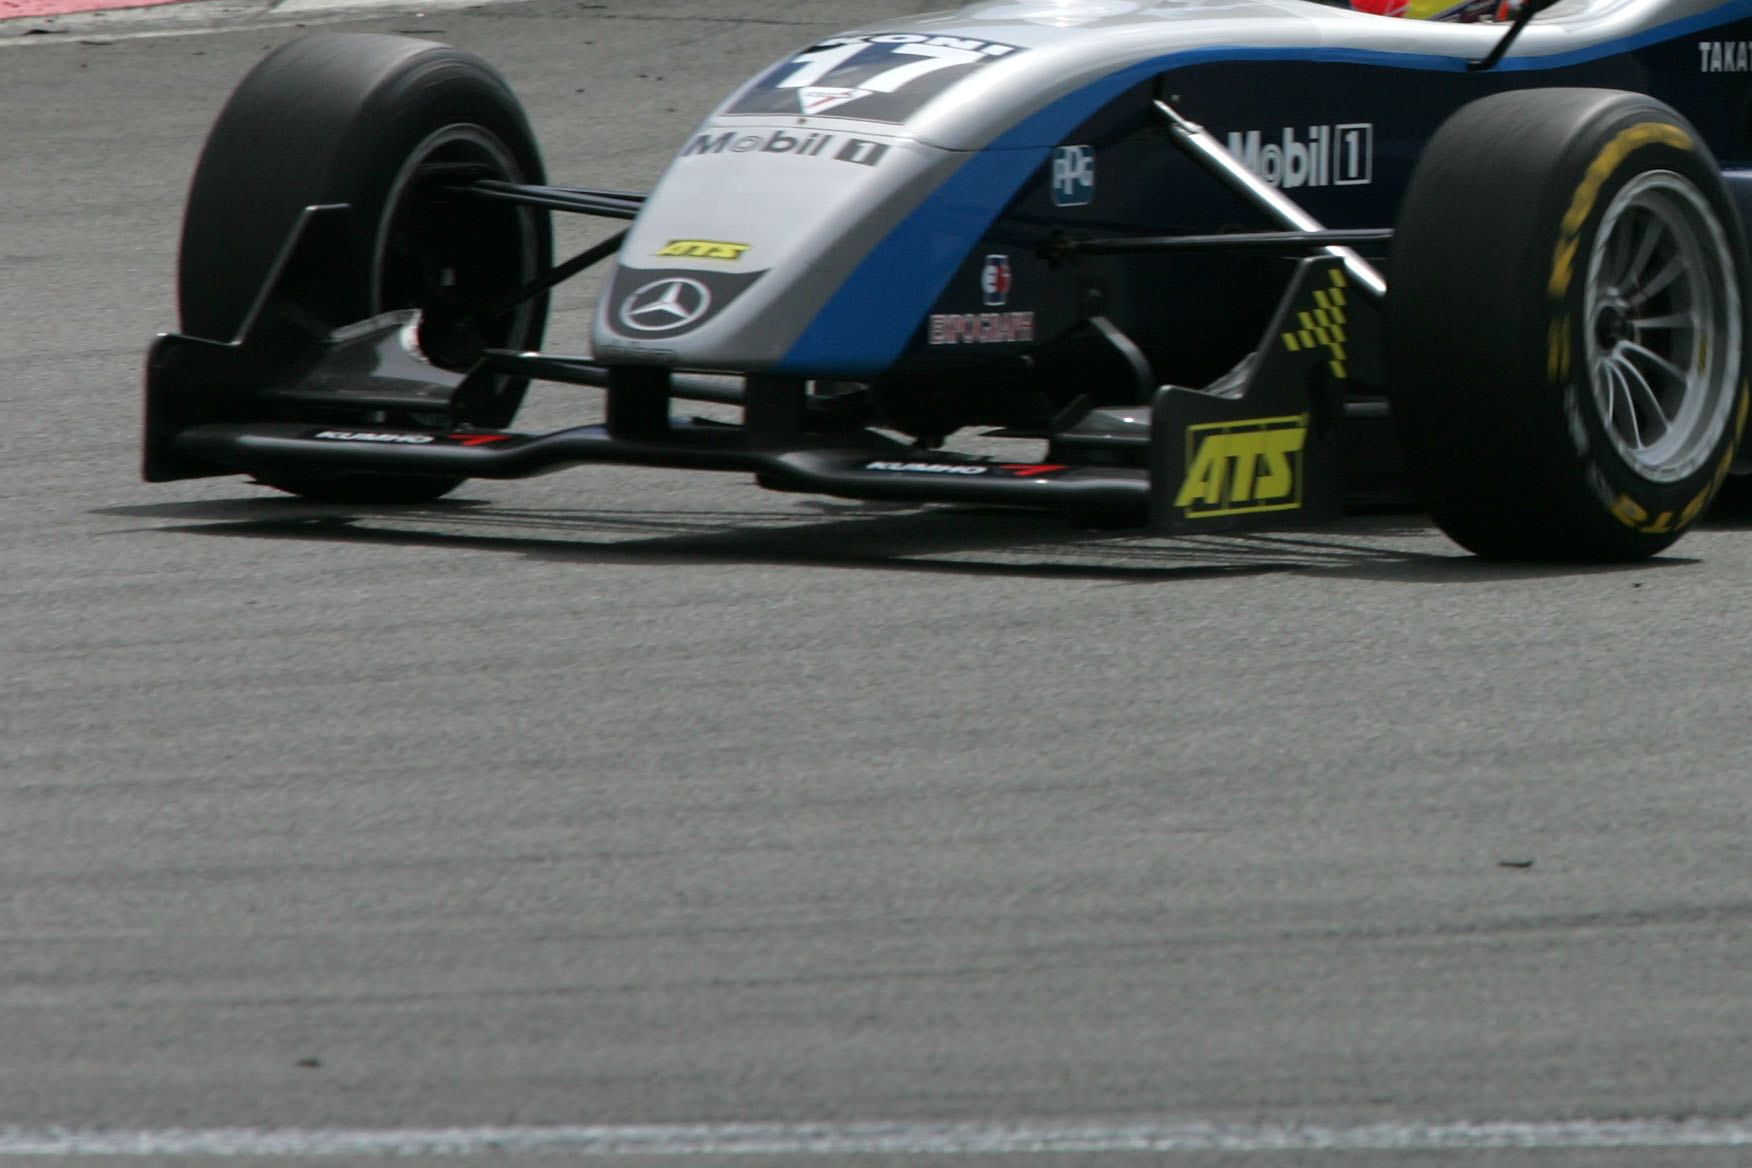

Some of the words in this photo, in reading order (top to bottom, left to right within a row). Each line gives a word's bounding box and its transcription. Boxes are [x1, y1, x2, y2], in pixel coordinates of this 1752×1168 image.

[777, 42, 988, 93] 17
[679, 130, 834, 157] Mobil
[1228, 125, 1329, 188] Mobil
[1056, 148, 1094, 196] PPG
[657, 240, 751, 259] ATS
[314, 431, 434, 444] KUMHO
[865, 461, 988, 474] KUMHO
[1174, 426, 1307, 507] ATS
